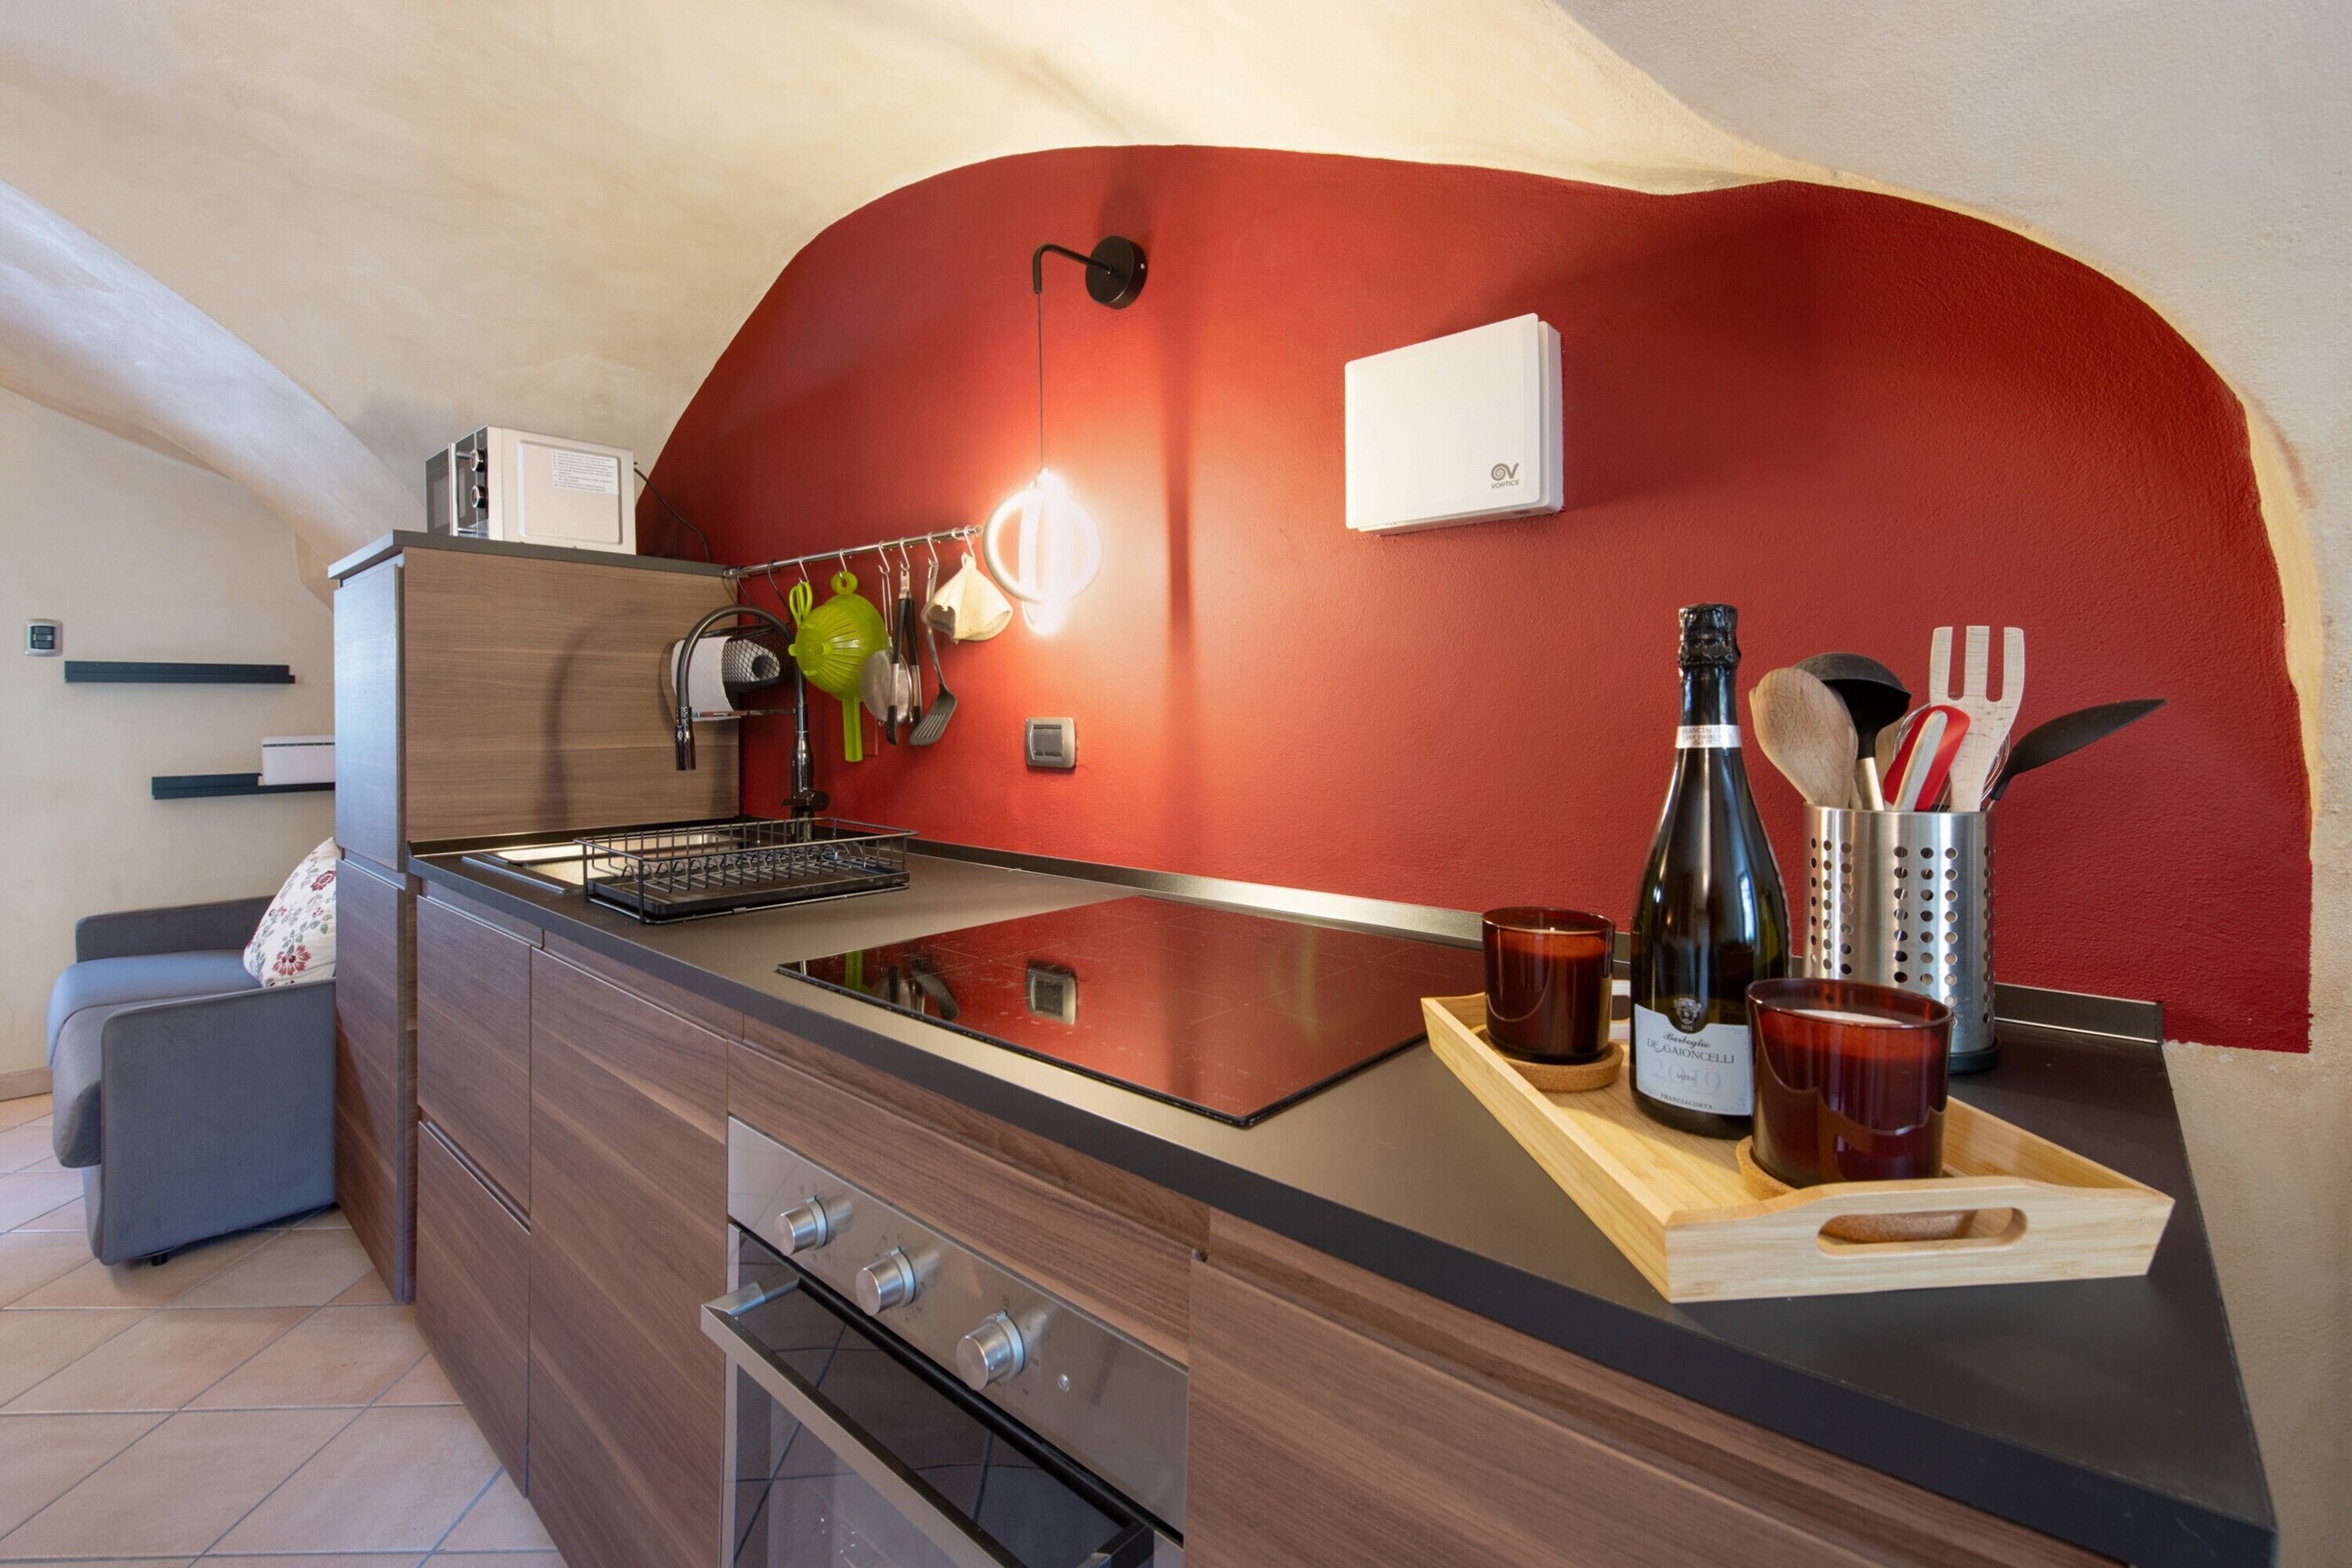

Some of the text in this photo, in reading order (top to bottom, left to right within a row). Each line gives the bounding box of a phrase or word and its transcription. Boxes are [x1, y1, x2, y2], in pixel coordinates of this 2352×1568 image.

[1647, 1037, 1735, 1064] DE GAIONCELLI
[1661, 1093, 1713, 1110] FRANCIACORTA
